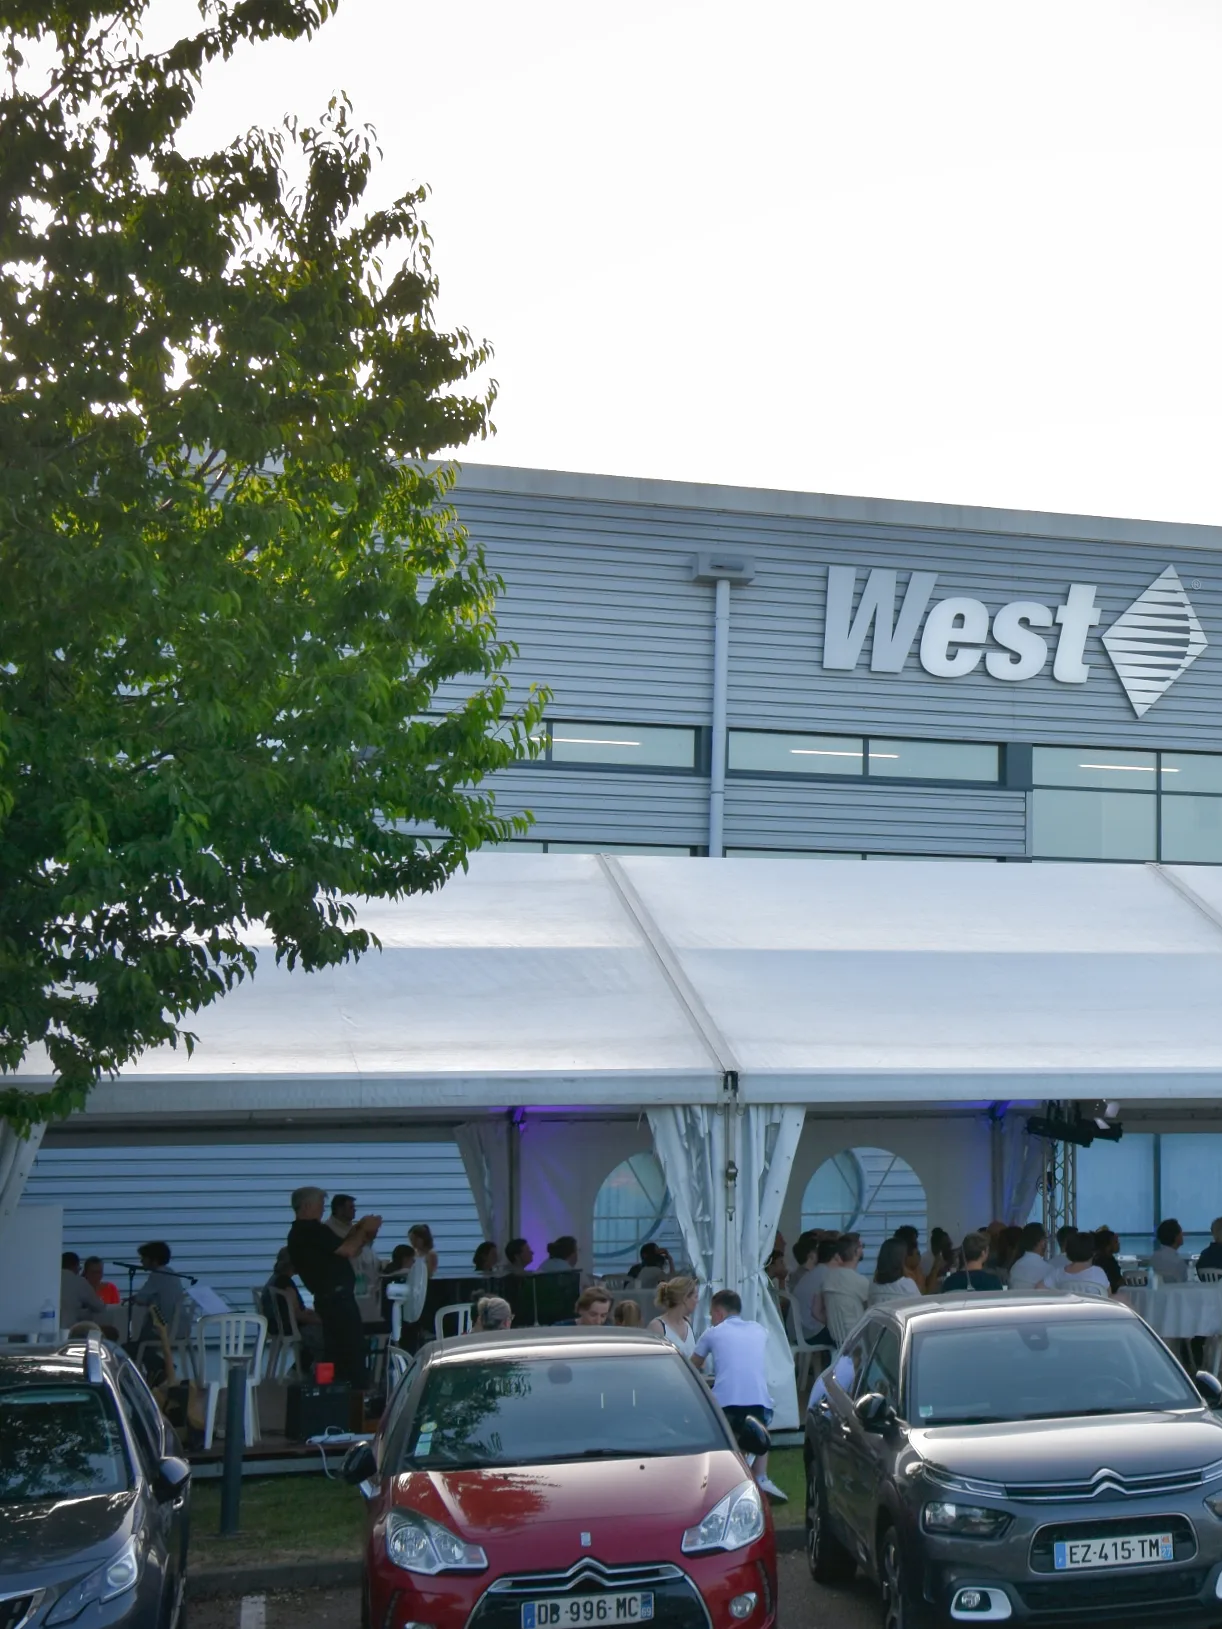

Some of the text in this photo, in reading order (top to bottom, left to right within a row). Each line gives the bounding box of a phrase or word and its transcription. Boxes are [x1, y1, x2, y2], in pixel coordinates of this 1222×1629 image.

[822, 565, 1101, 683] West
[1069, 1538, 1160, 1564] EZ-415-TM
[537, 1596, 638, 1626] DB-996-MC
